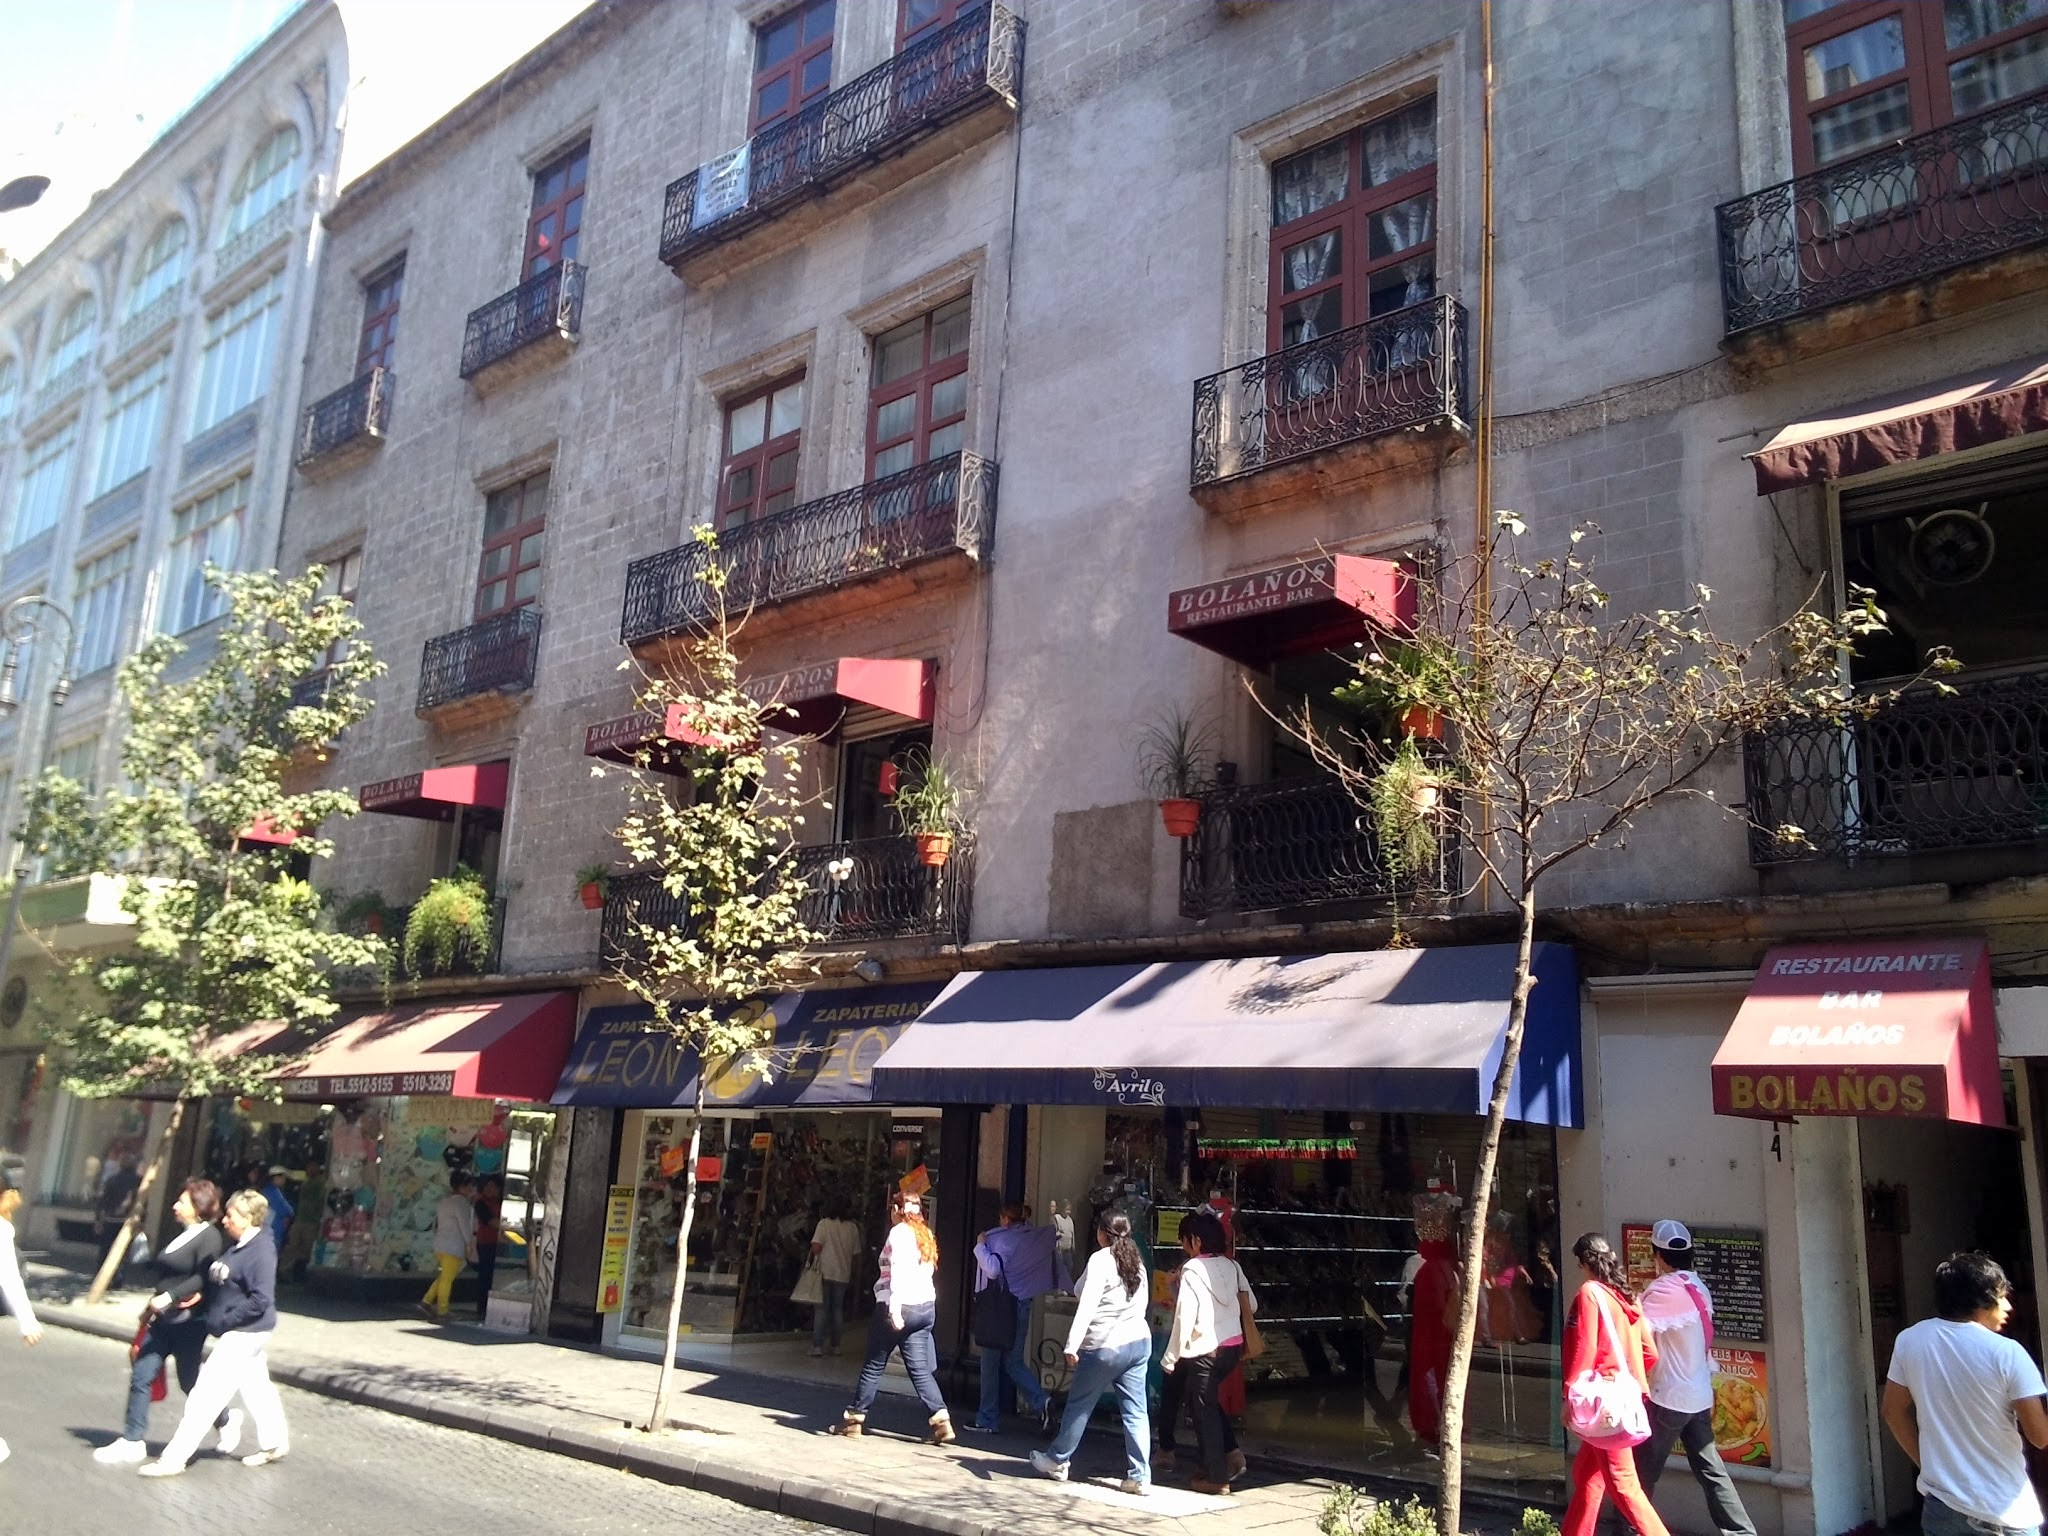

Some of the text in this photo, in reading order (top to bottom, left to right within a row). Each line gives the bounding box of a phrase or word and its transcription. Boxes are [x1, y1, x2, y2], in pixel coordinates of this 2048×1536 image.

[1178, 562, 1328, 613] BOLAÑOS
[1186, 586, 1315, 625] RESTAURANTE BAR
[1771, 953, 1963, 975] RESTAURANTE
[1817, 990, 1884, 1009] BAR
[1768, 1021, 1905, 1046] BOLAÑOS
[787, 1022, 907, 1083] LEO
[402, 1073, 452, 1093] 5510-3293
[1106, 1077, 1152, 1094] Avril
[1729, 1067, 1927, 1113] BOLAÑOS
[1709, 1349, 1754, 1364] EBE LA
[1719, 1363, 1758, 1379] NTICA
